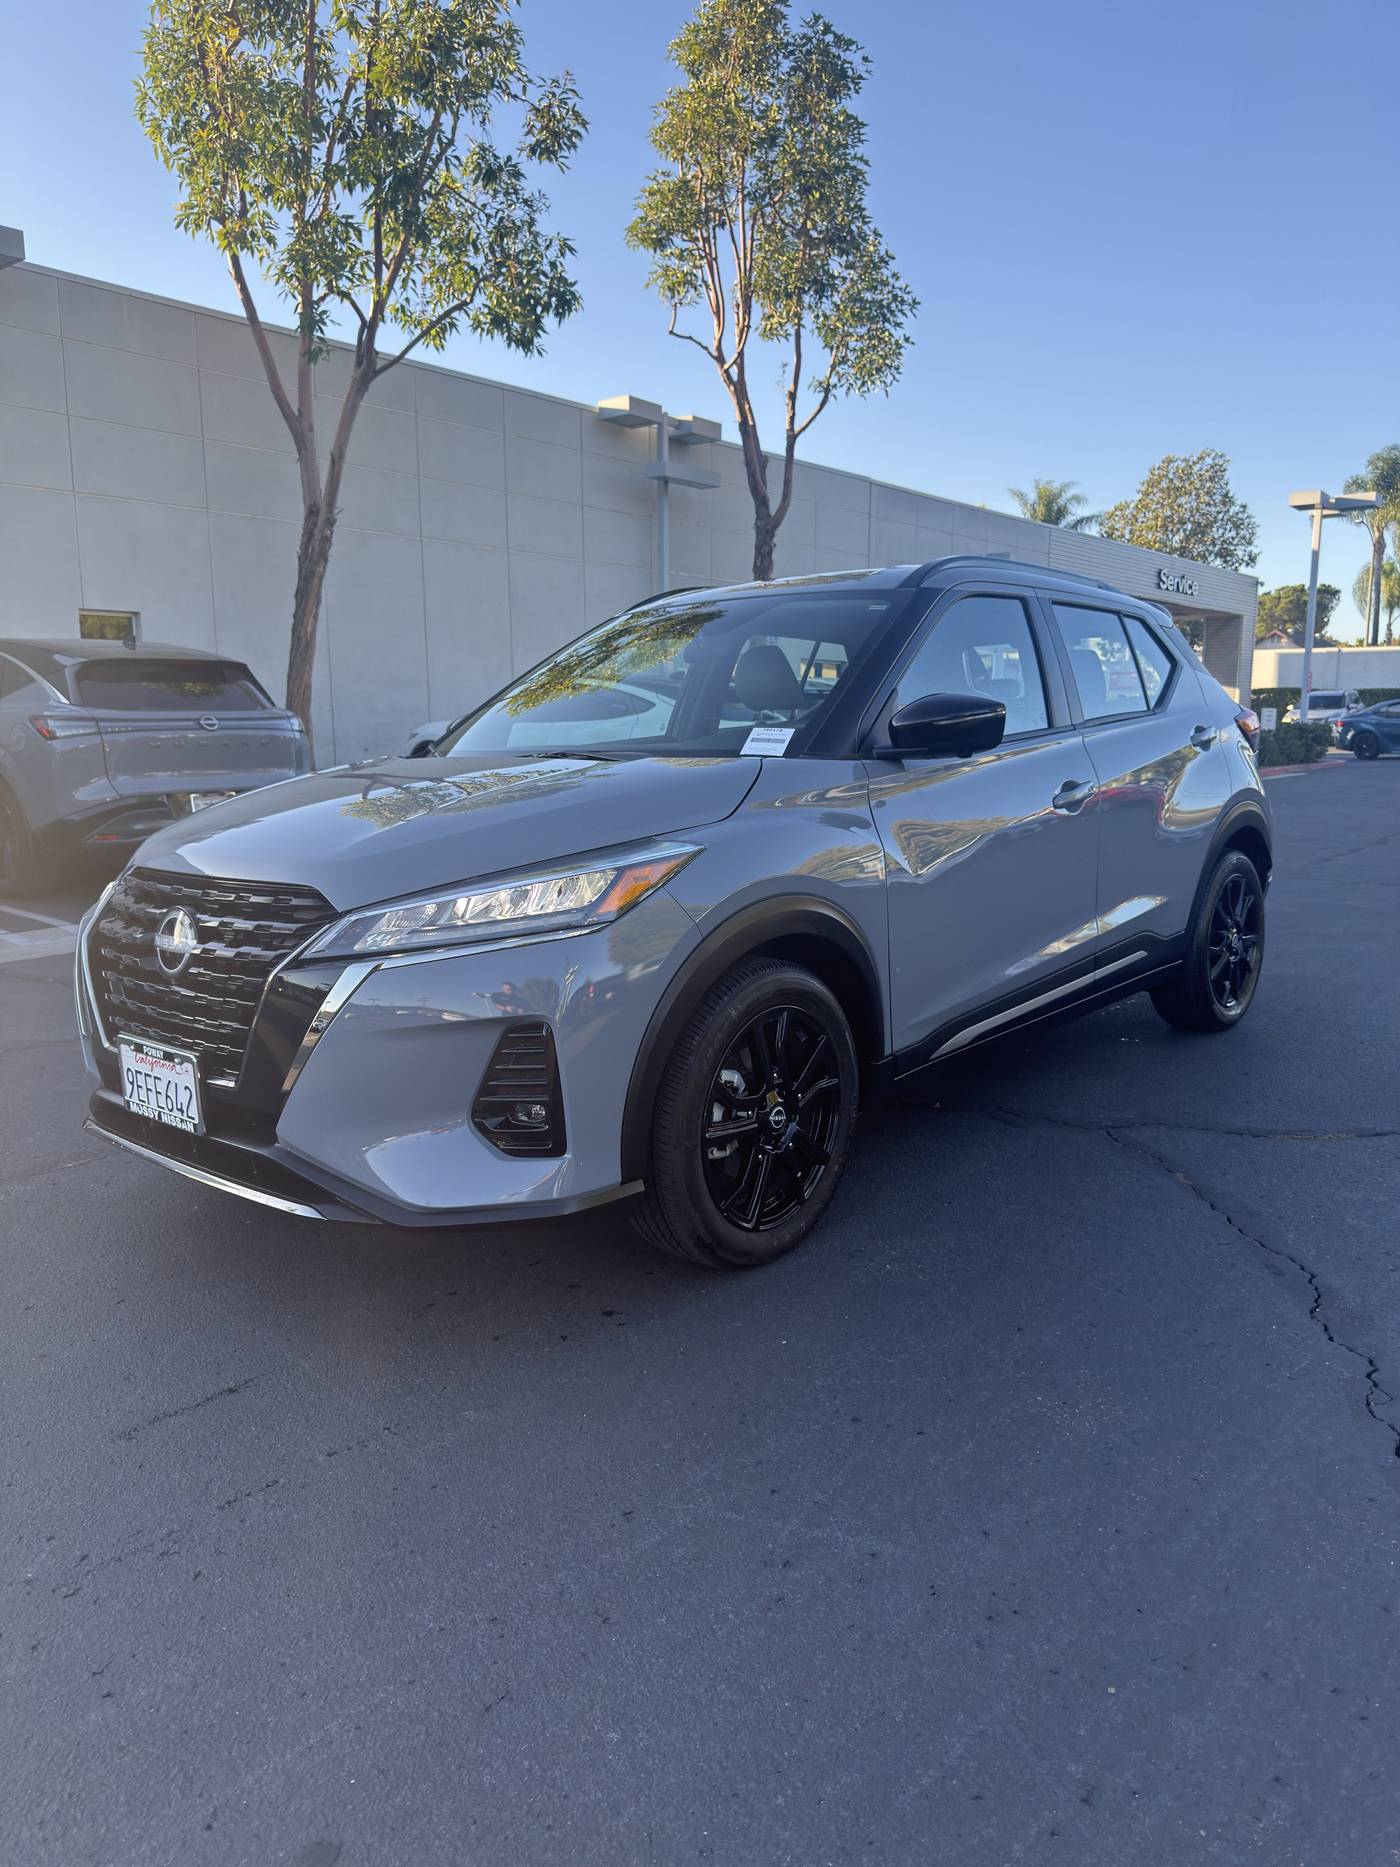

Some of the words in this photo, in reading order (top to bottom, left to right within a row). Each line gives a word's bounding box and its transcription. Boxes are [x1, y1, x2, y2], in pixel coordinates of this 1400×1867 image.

[1159, 569, 1199, 595] Service
[134, 1053, 182, 1075] California
[143, 1046, 164, 1059] POWAY
[126, 1067, 196, 1120] 9EFE642
[129, 1101, 159, 1120] MOSSY
[160, 1112, 194, 1133] NISSAN
